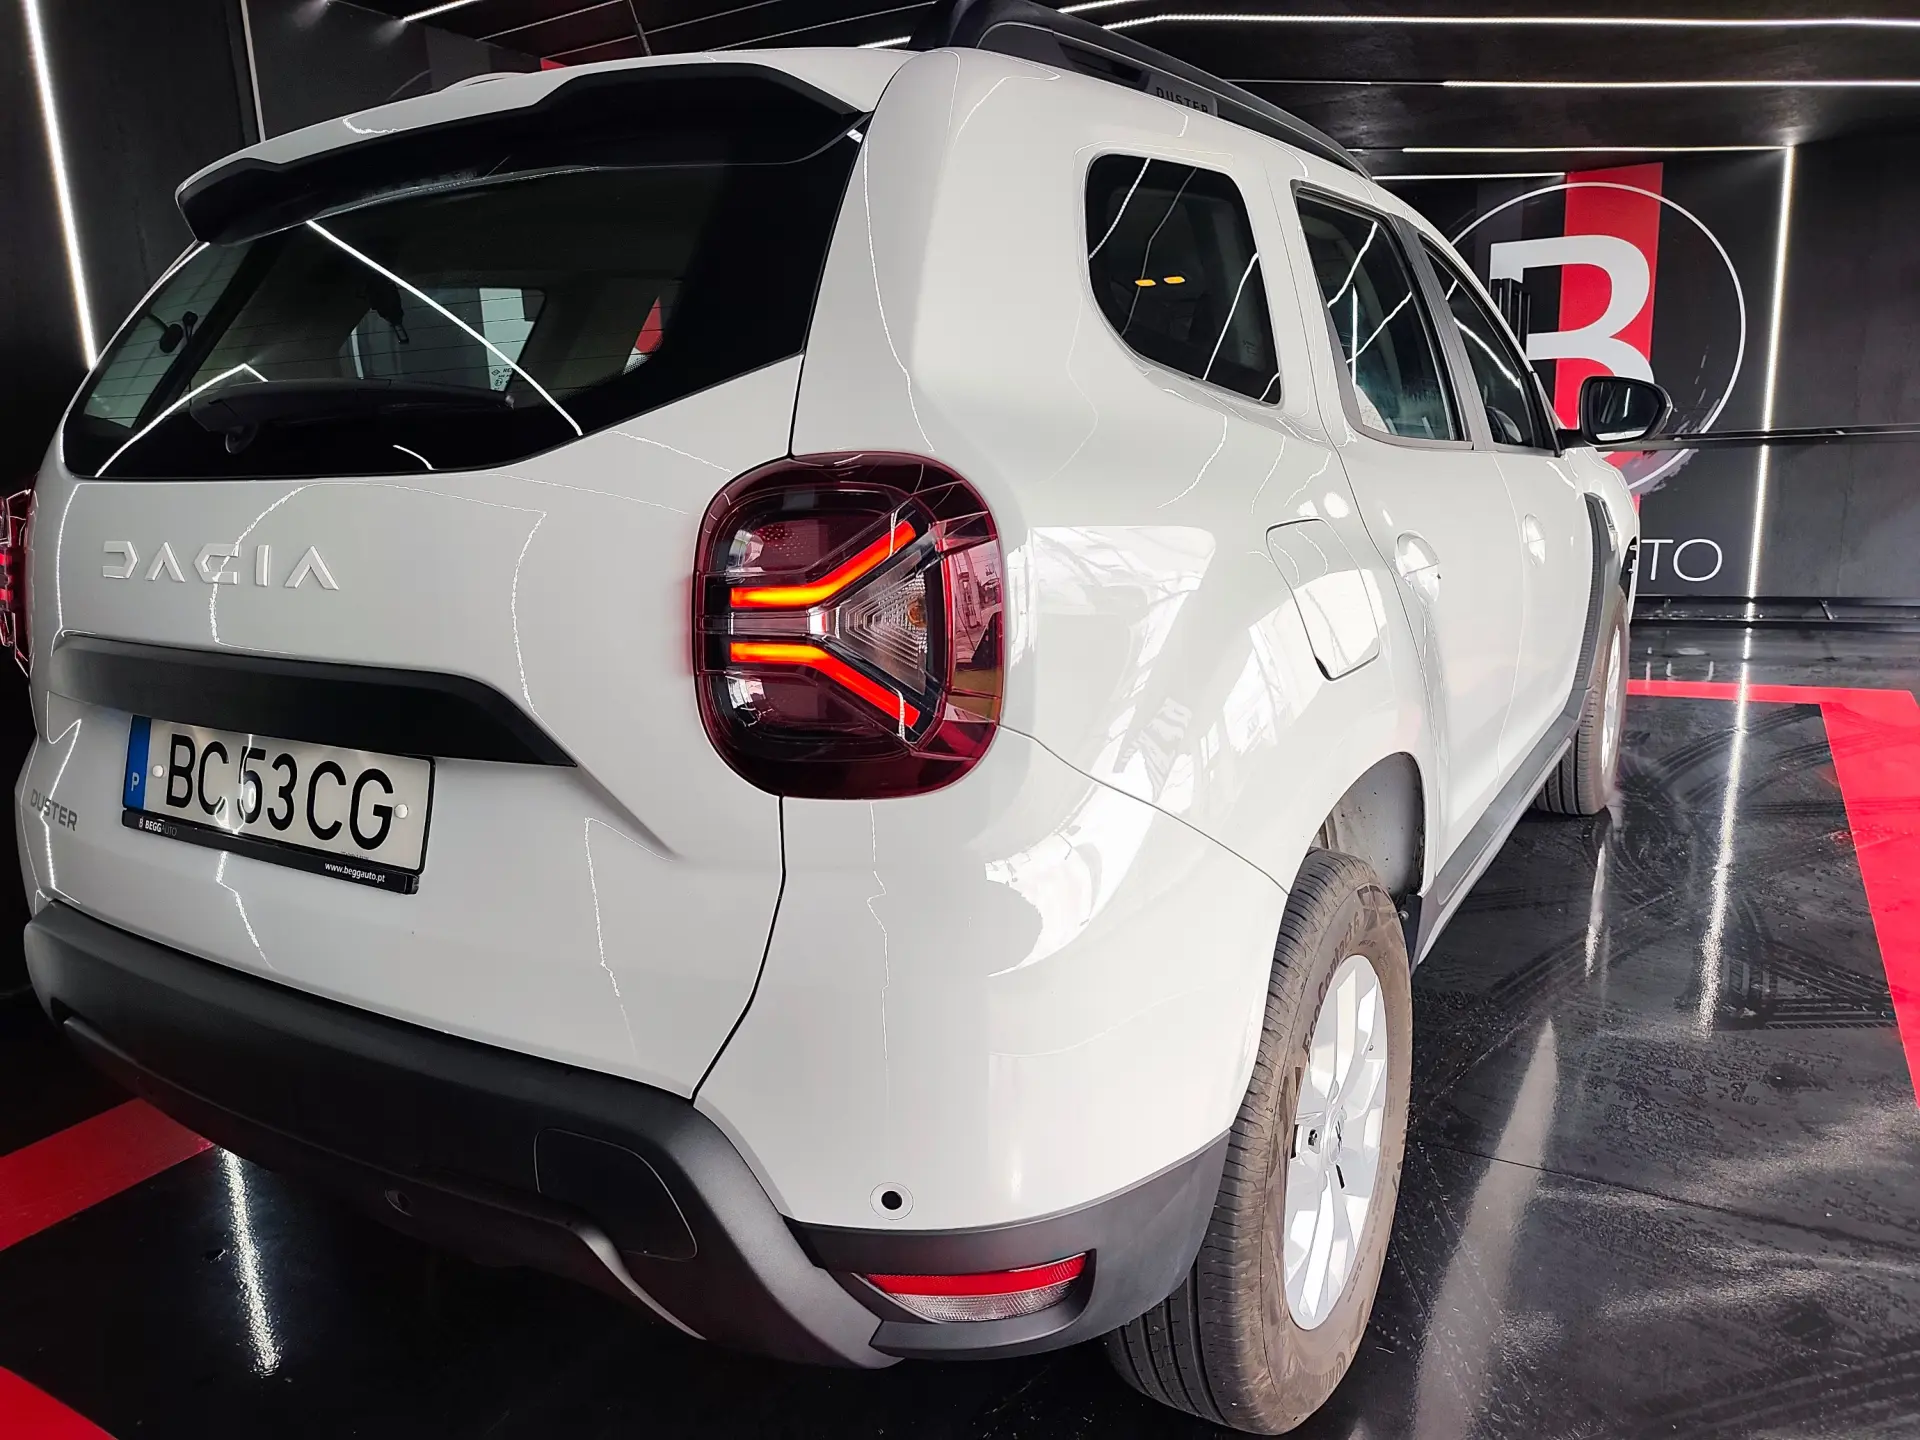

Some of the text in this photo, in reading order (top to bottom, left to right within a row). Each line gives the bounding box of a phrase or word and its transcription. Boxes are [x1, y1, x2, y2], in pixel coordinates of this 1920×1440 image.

[1156, 87, 1209, 114] DUSTER
[102, 540, 340, 591] DACIA
[30, 788, 78, 832] DUSTER
[324, 862, 386, 883] www.beggauto.pt
